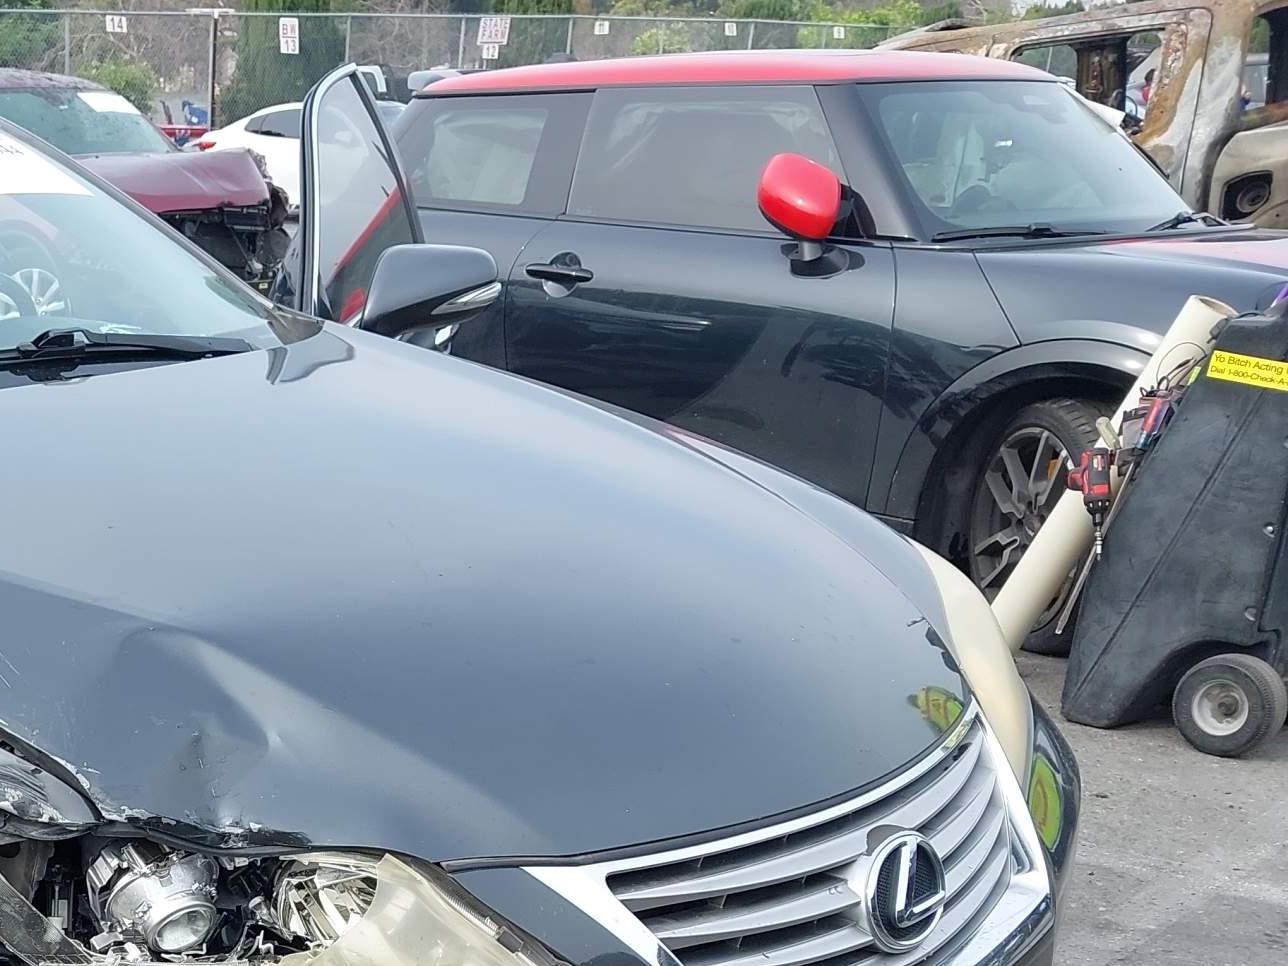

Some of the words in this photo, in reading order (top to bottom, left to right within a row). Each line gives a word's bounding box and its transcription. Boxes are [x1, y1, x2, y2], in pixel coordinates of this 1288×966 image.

[110, 17, 123, 31] 14
[481, 18, 509, 29] STATE
[480, 29, 506, 40] FARM
[285, 39, 297, 52] 13
[486, 45, 497, 58] 12
[1215, 355, 1225, 363] Yo
[1228, 356, 1251, 368] Bitch
[1253, 361, 1284, 375] Acting
